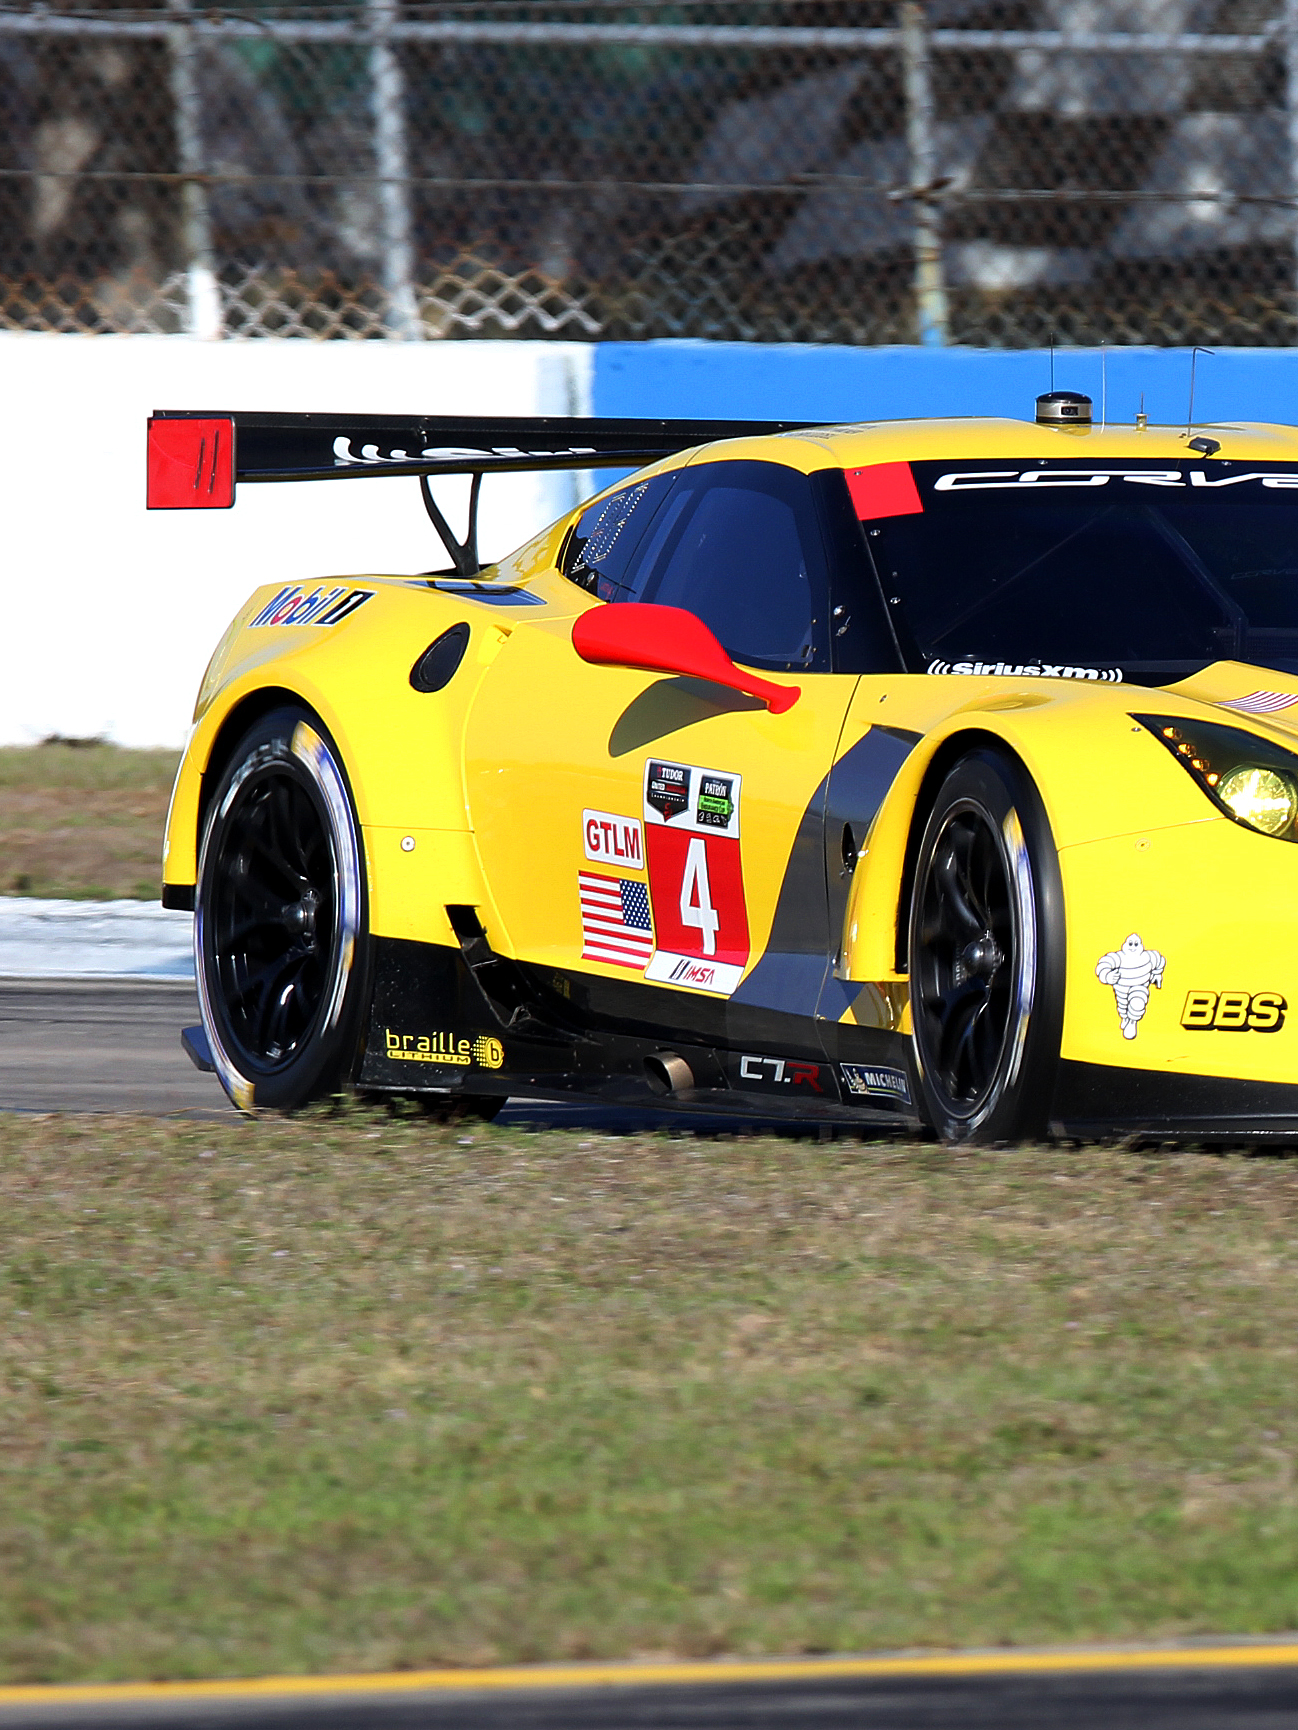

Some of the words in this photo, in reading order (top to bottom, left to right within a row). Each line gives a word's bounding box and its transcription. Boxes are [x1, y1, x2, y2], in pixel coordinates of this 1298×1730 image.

[248, 586, 347, 627] Mobil
[661, 767, 684, 781] TUDOR
[586, 819, 641, 860] GTLM
[680, 837, 720, 956] 4
[683, 965, 715, 985] IMSA
[1180, 991, 1288, 1033] BBS
[386, 1028, 471, 1055] braille
[389, 1051, 470, 1064] LITHIUM
[864, 1072, 907, 1094] MICHELIN
